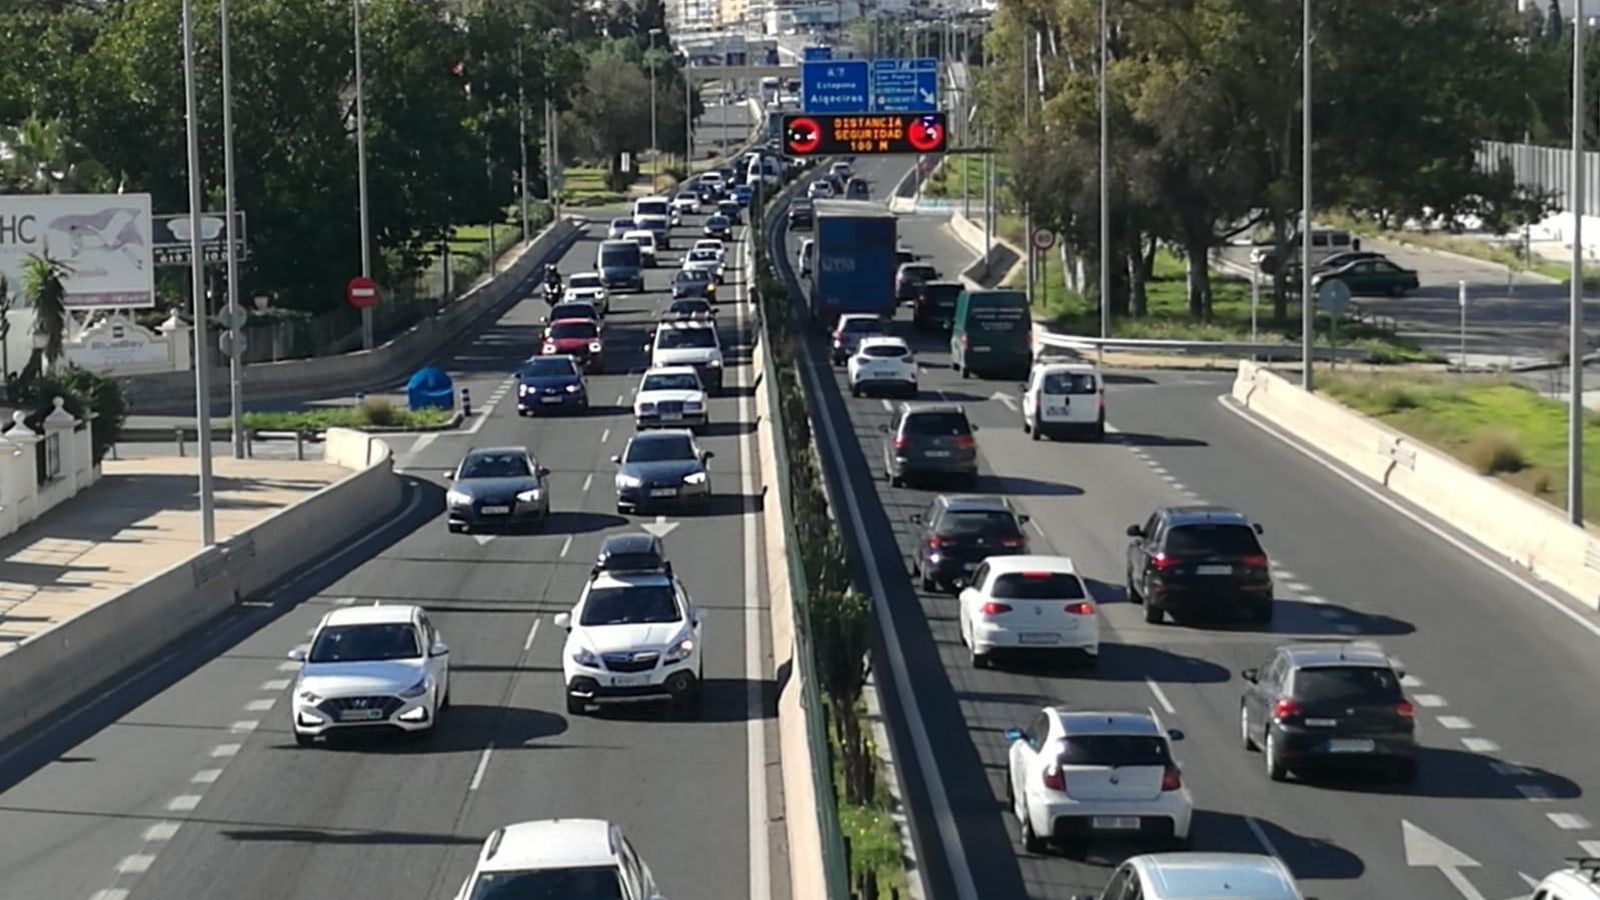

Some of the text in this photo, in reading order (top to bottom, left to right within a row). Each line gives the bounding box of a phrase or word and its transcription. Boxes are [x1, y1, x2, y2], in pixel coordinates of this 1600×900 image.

[810, 94, 863, 105] Algeciras
[834, 117, 902, 128] DISTANCIA
[834, 129, 902, 140] SEGURIDAD
[851, 140, 888, 151] 100 M
